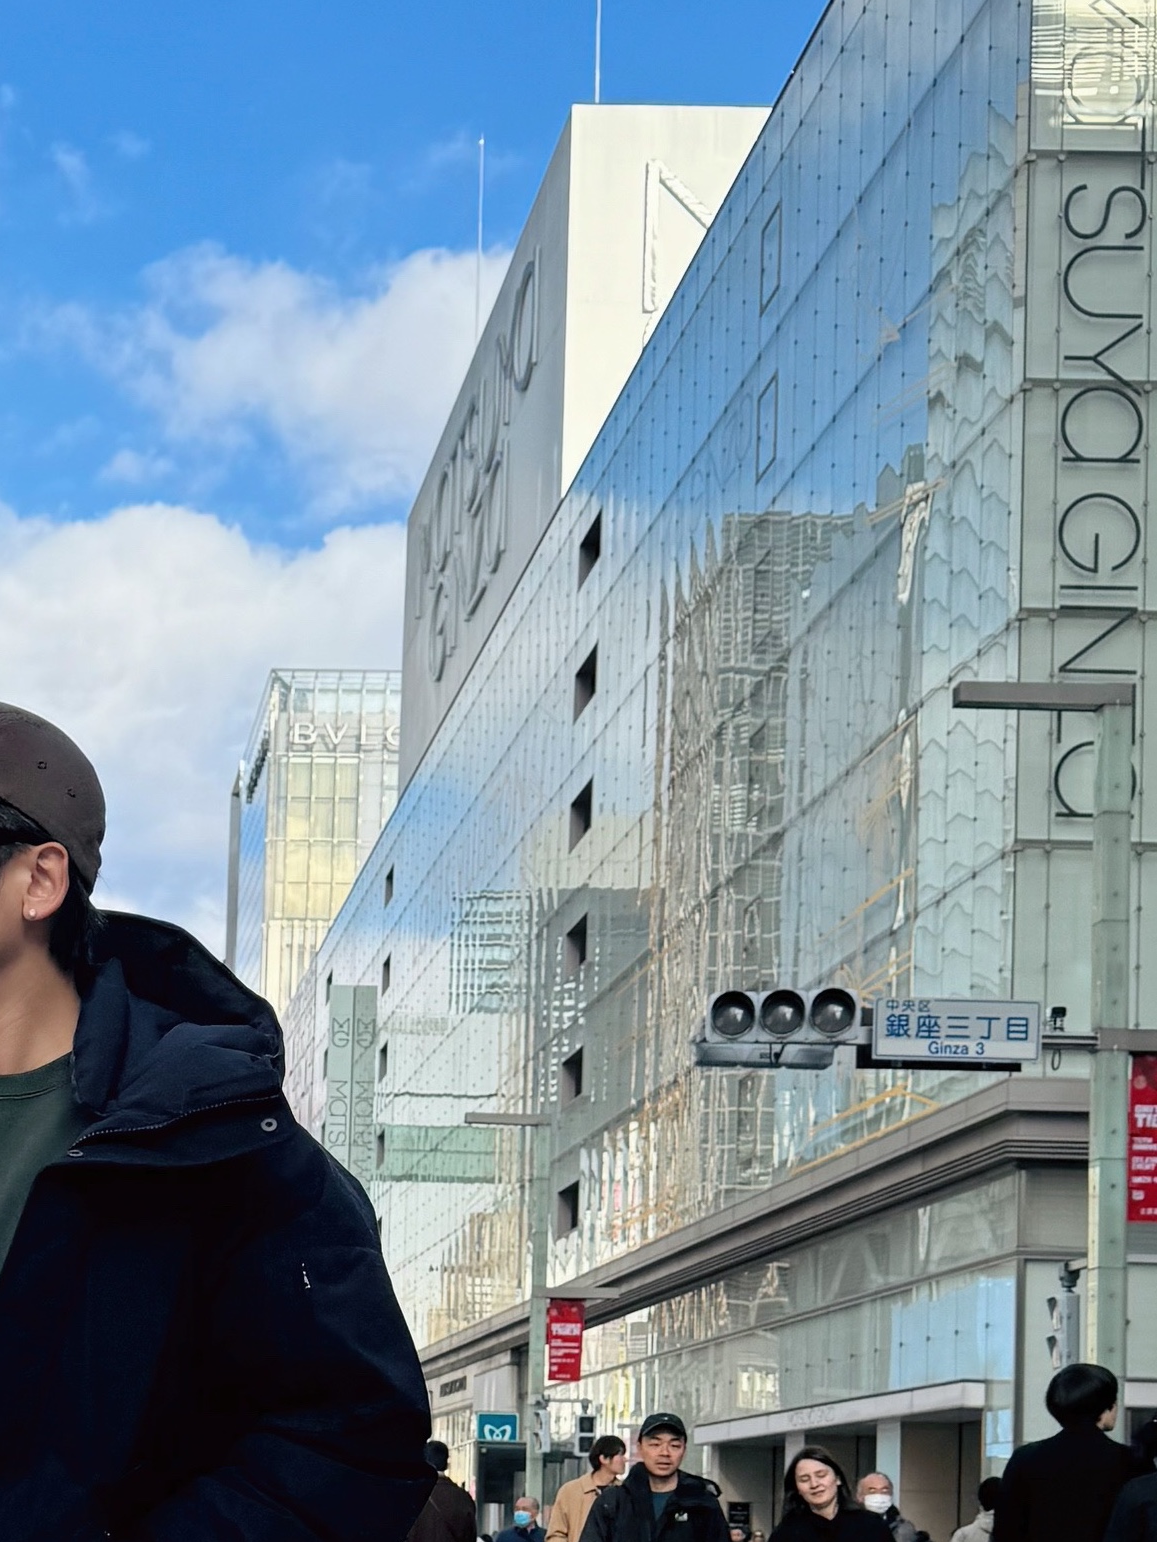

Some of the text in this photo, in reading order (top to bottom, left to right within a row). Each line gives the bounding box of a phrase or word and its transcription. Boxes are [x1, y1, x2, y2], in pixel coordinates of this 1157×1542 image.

[885, 1000, 932, 1013] 中央区
[885, 1013, 1030, 1041] 銀座三丁目
[928, 1041, 985, 1055] Ginza 3
